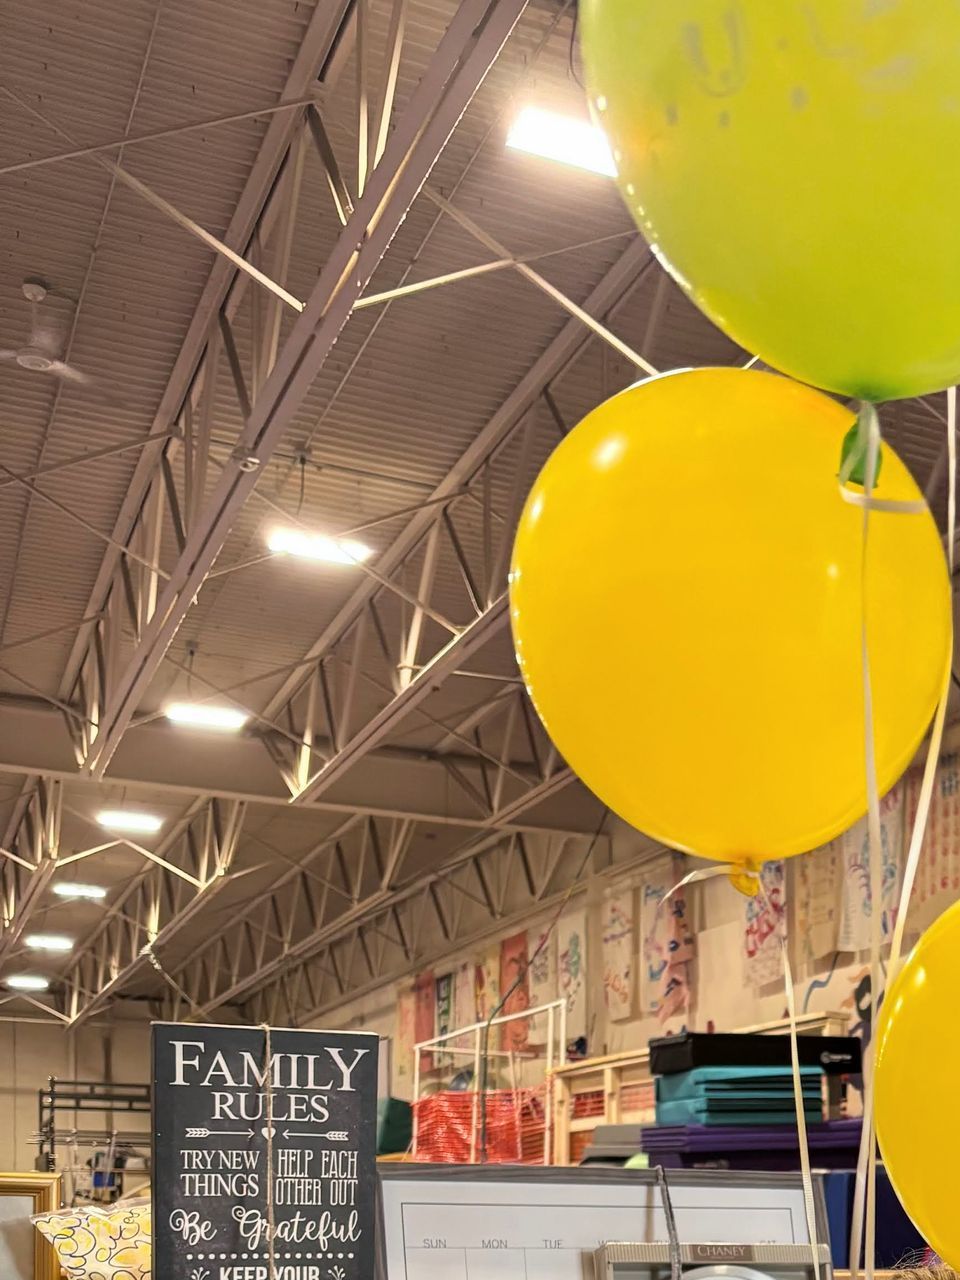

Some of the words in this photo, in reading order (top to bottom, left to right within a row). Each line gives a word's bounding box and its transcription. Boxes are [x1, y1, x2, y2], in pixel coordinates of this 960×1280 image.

[169, 1040, 370, 1092] FAMILY
[211, 1092, 329, 1122] RULES
[181, 1150, 215, 1170] TRY
[217, 1150, 260, 1171] NEW
[277, 1150, 314, 1178] HELP
[321, 1151, 358, 1179] EACH
[181, 1174, 260, 1197] THINGS
[276, 1178, 323, 1205] OTHER
[330, 1179, 358, 1206] OUT
[169, 1208, 217, 1243] Be
[231, 1205, 361, 1251] Grateful
[423, 1239, 447, 1250] SUN
[481, 1239, 508, 1250] MON
[542, 1239, 564, 1250] TUE
[697, 1245, 746, 1258] CHANEY
